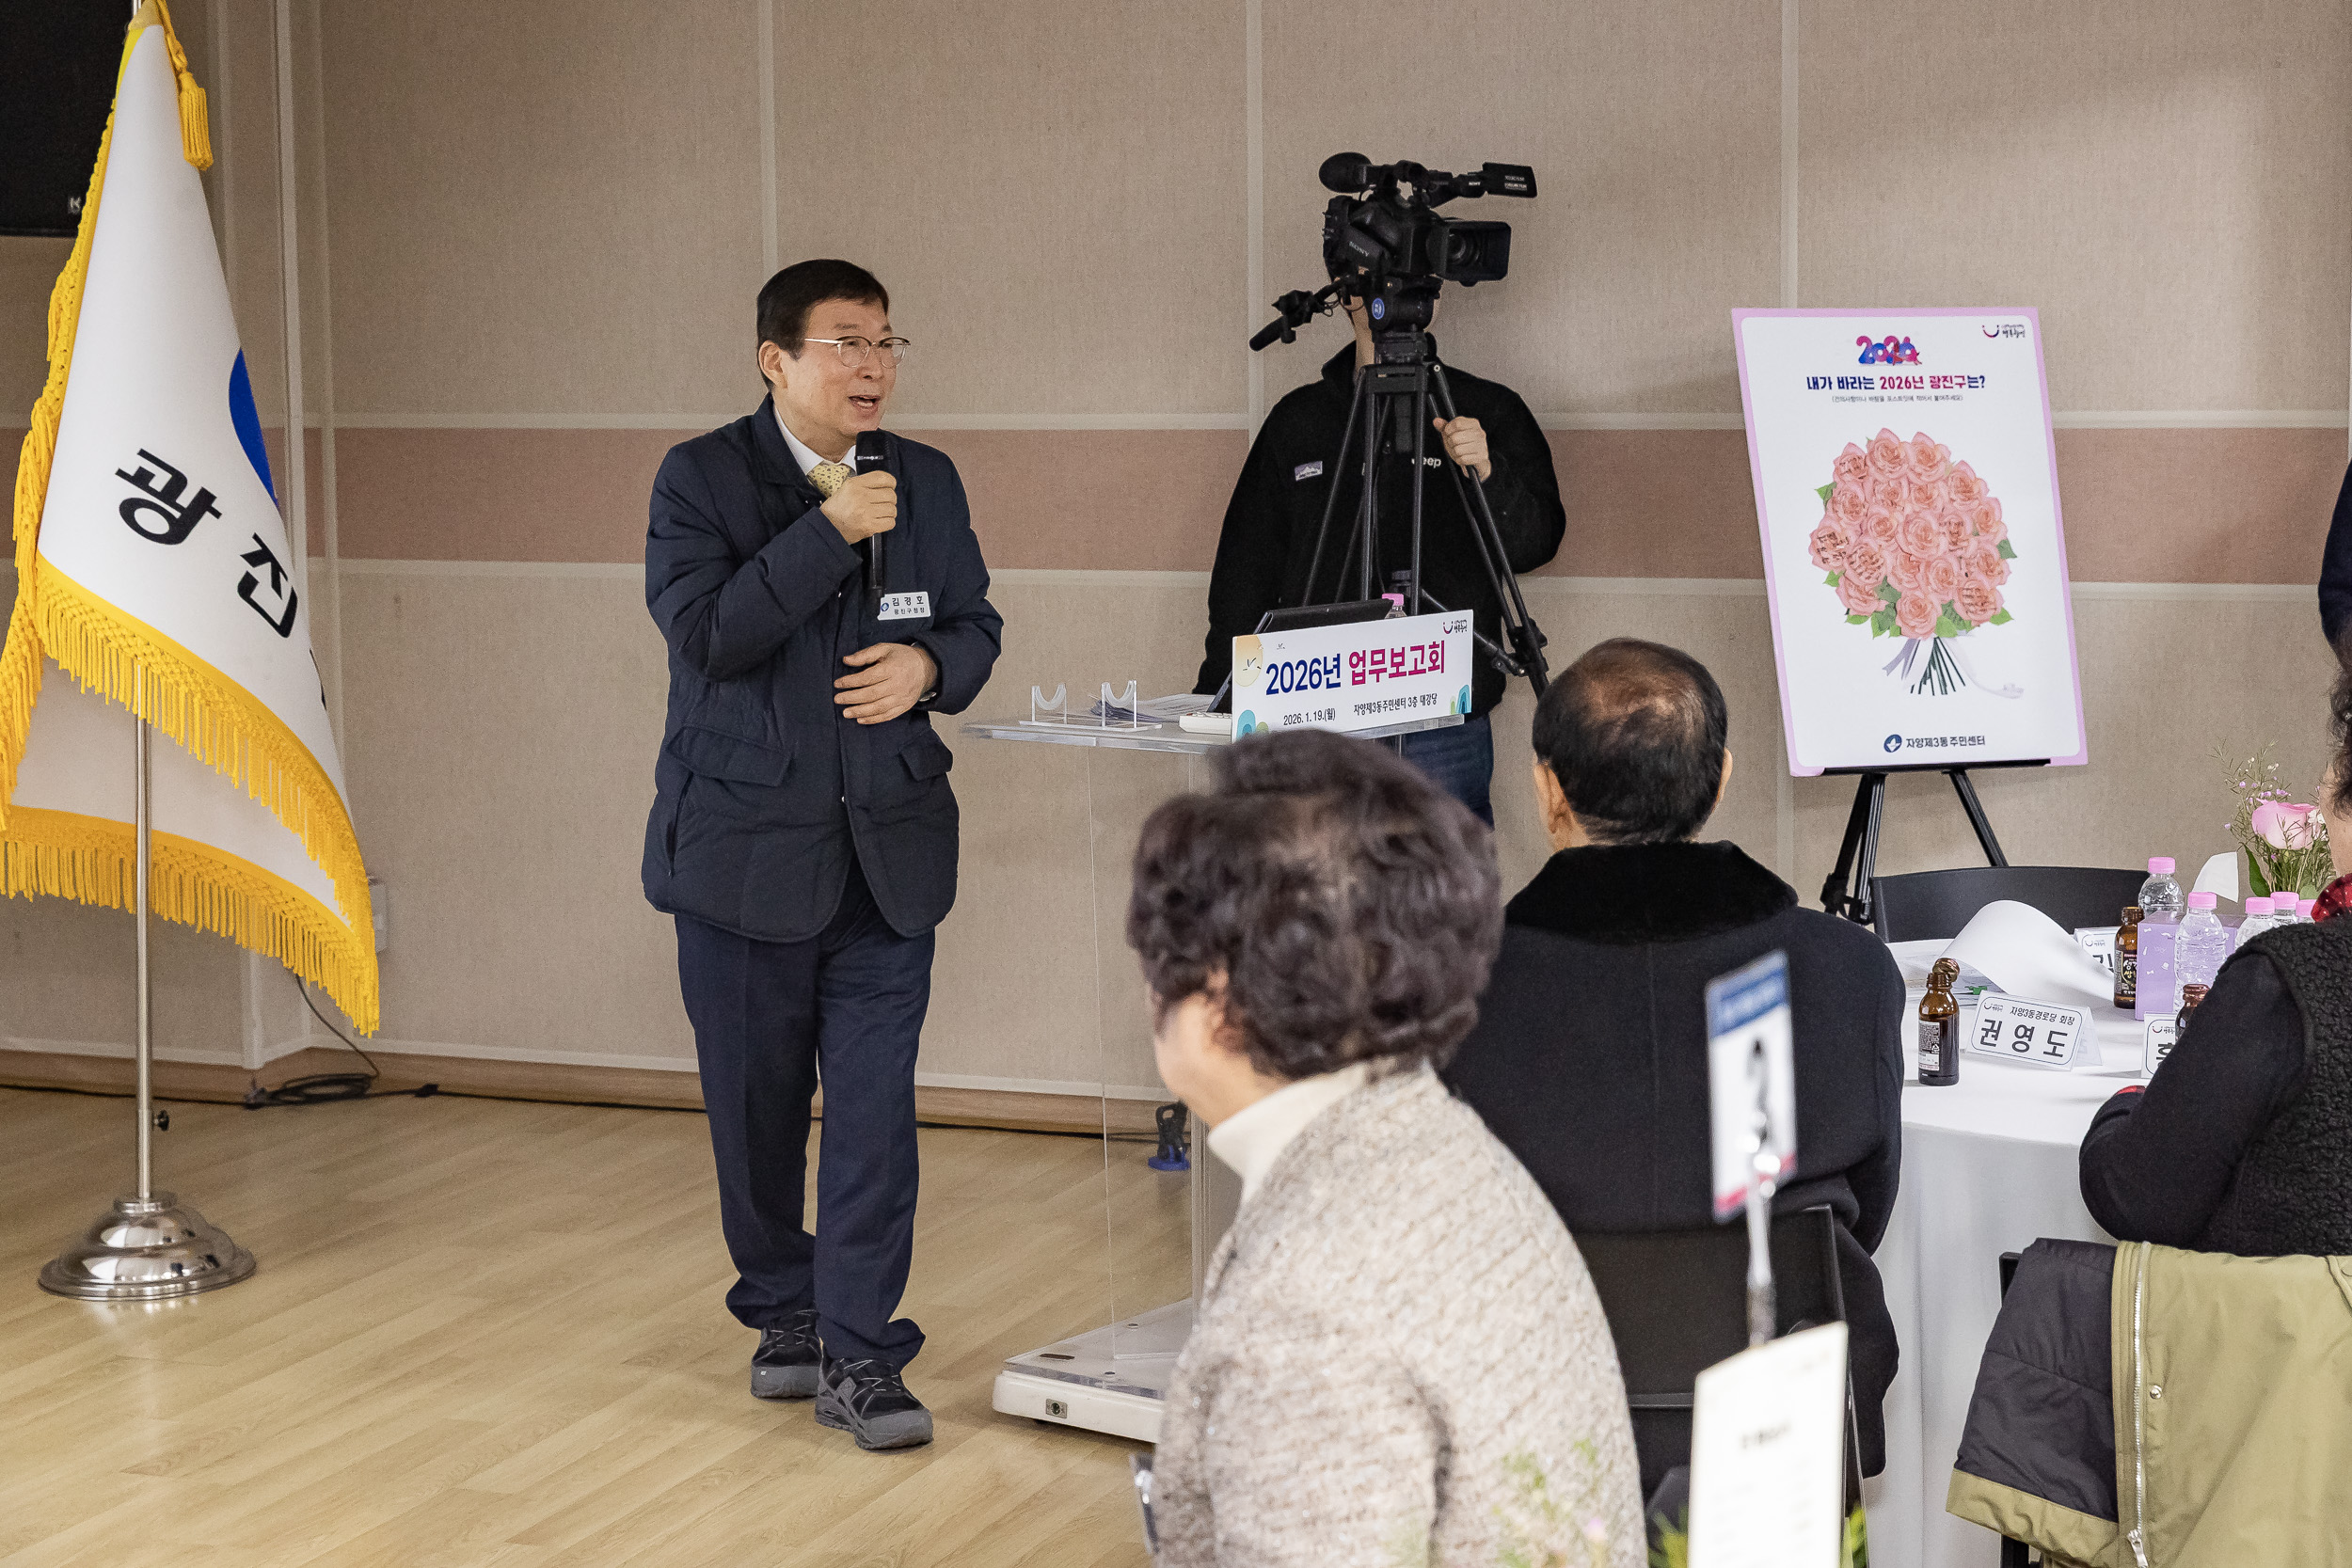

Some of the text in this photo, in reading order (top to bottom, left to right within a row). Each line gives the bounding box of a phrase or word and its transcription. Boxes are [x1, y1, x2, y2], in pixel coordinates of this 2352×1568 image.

[1806, 374, 1986, 390] 내가 바라는 2026년 광진구는?
[1265, 640, 1446, 696] 2026년 업무보고회
[1353, 692, 1438, 717] 자양제3동주민센터 3층 대강당
[1283, 715, 1305, 726] 2026.
[2010, 1006, 2058, 1022] 자양3동경로당
[2058, 1015, 2075, 1026] 회장
